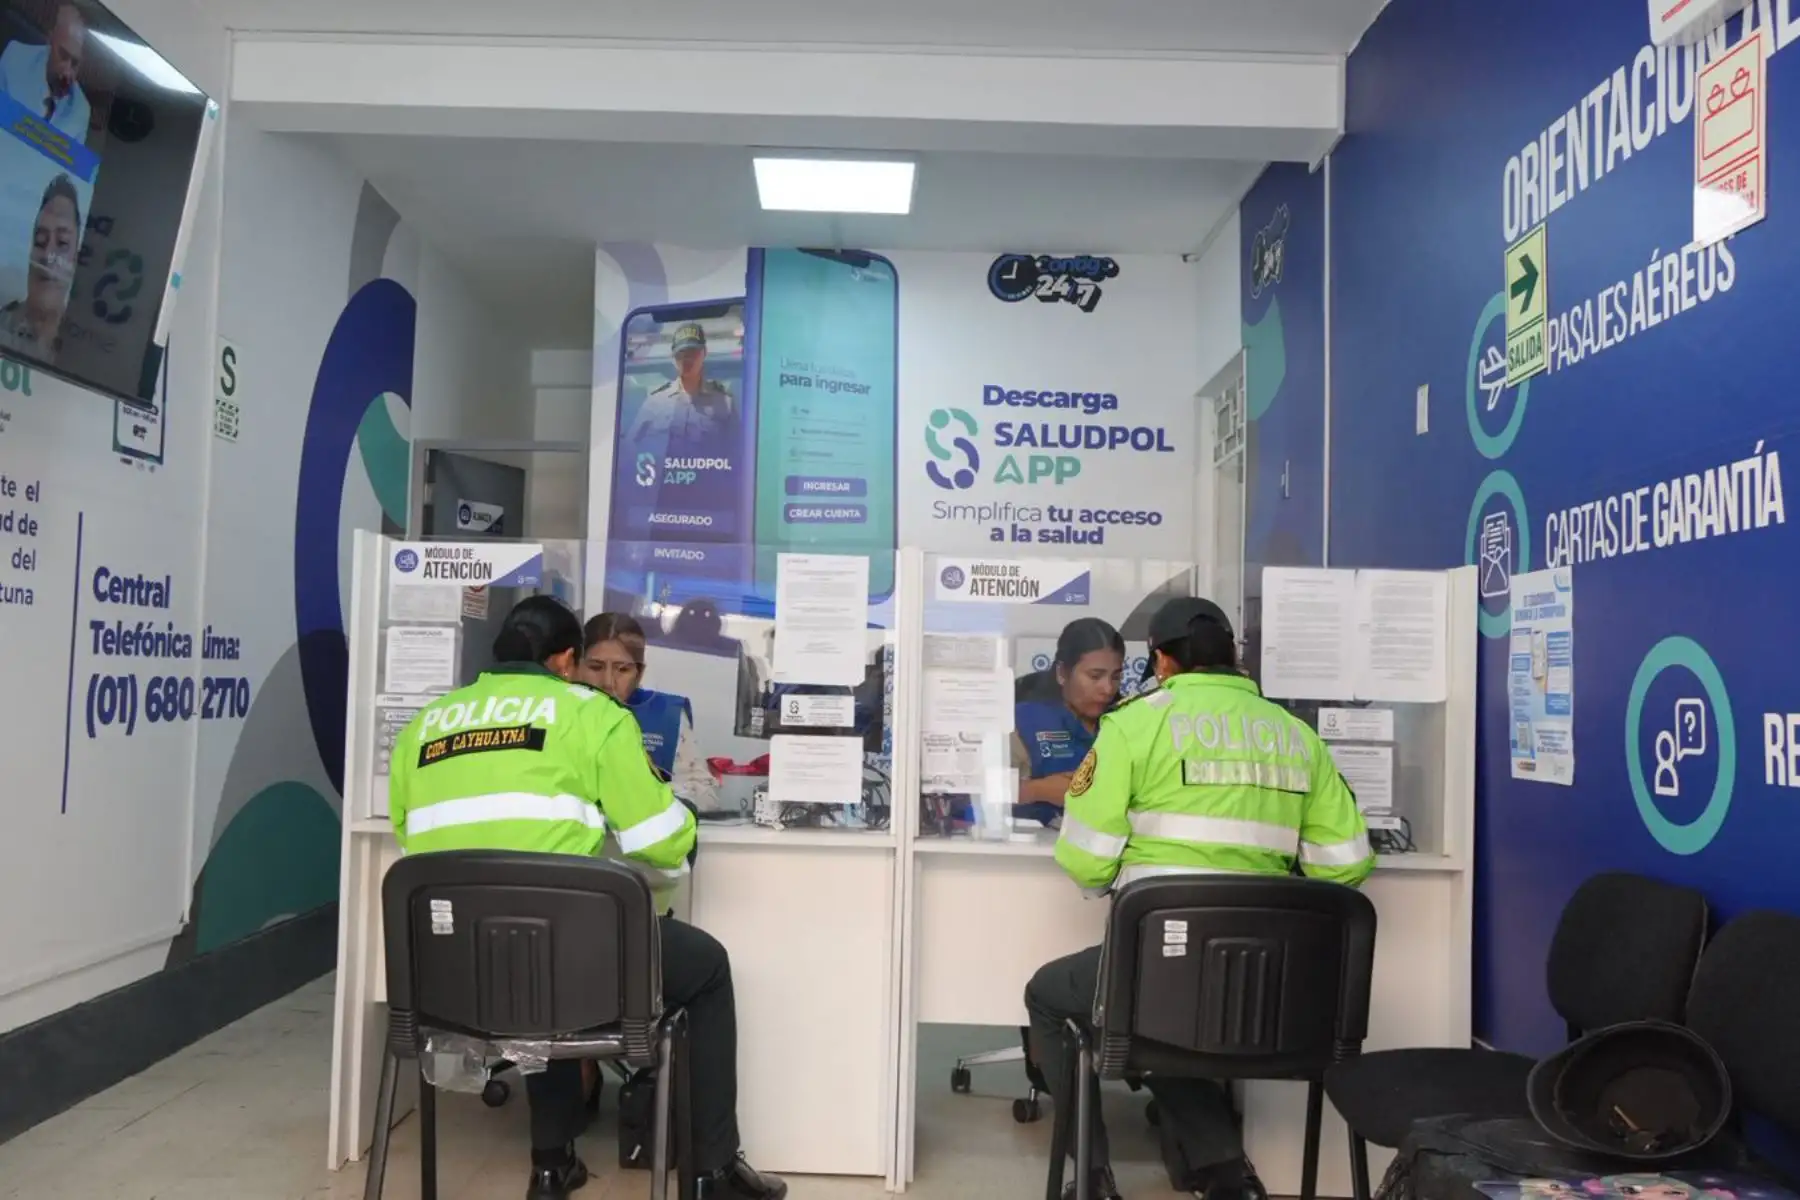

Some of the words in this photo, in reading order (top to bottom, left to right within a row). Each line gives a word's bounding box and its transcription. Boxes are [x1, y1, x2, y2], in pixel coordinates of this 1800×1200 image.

[1547, 280, 1627, 375] PASAJES
[1509, 331, 1542, 372] SALIDA
[220, 345, 237, 396] S
[779, 373, 813, 388] para
[815, 374, 871, 396] ingresar
[983, 384, 1118, 414] Descarga
[994, 422, 1175, 452] SALUDPOL
[664, 457, 732, 471] SALUDPOL
[993, 454, 1081, 485] APP
[664, 471, 696, 485] APP
[803, 481, 850, 493] INGRESAR
[25, 480, 40, 502] el
[789, 507, 822, 518] CREAR
[824, 508, 861, 520] CUENTA
[932, 500, 1042, 525] Simplifica
[1048, 505, 1073, 523] tu
[1079, 508, 1163, 526] acceso
[1545, 496, 1619, 569] CARTAS
[1622, 487, 1649, 555] DE
[1653, 440, 1786, 547] GARANTÍA
[18, 513, 38, 536] de
[648, 513, 713, 527] ASEGURADO
[990, 527, 1004, 542] a
[1011, 525, 1032, 542] la
[1038, 525, 1104, 545] salud
[11, 546, 36, 571] del
[425, 546, 460, 560] MÓDULO
[462, 548, 473, 560] DE
[654, 548, 705, 561] INVITADO
[423, 559, 492, 580] ATENCIÓN
[971, 563, 1008, 577] MÓDULO
[1010, 565, 1021, 577] DE
[93, 567, 170, 608] Central
[970, 577, 1040, 598] ATENCIÓN
[90, 619, 192, 659] Telefónica
[87, 673, 138, 738] (01)
[145, 676, 195, 722] 680
[201, 676, 250, 720] 2710
[419, 696, 556, 741] POLICIA
[1169, 712, 1311, 762] POLICIA
